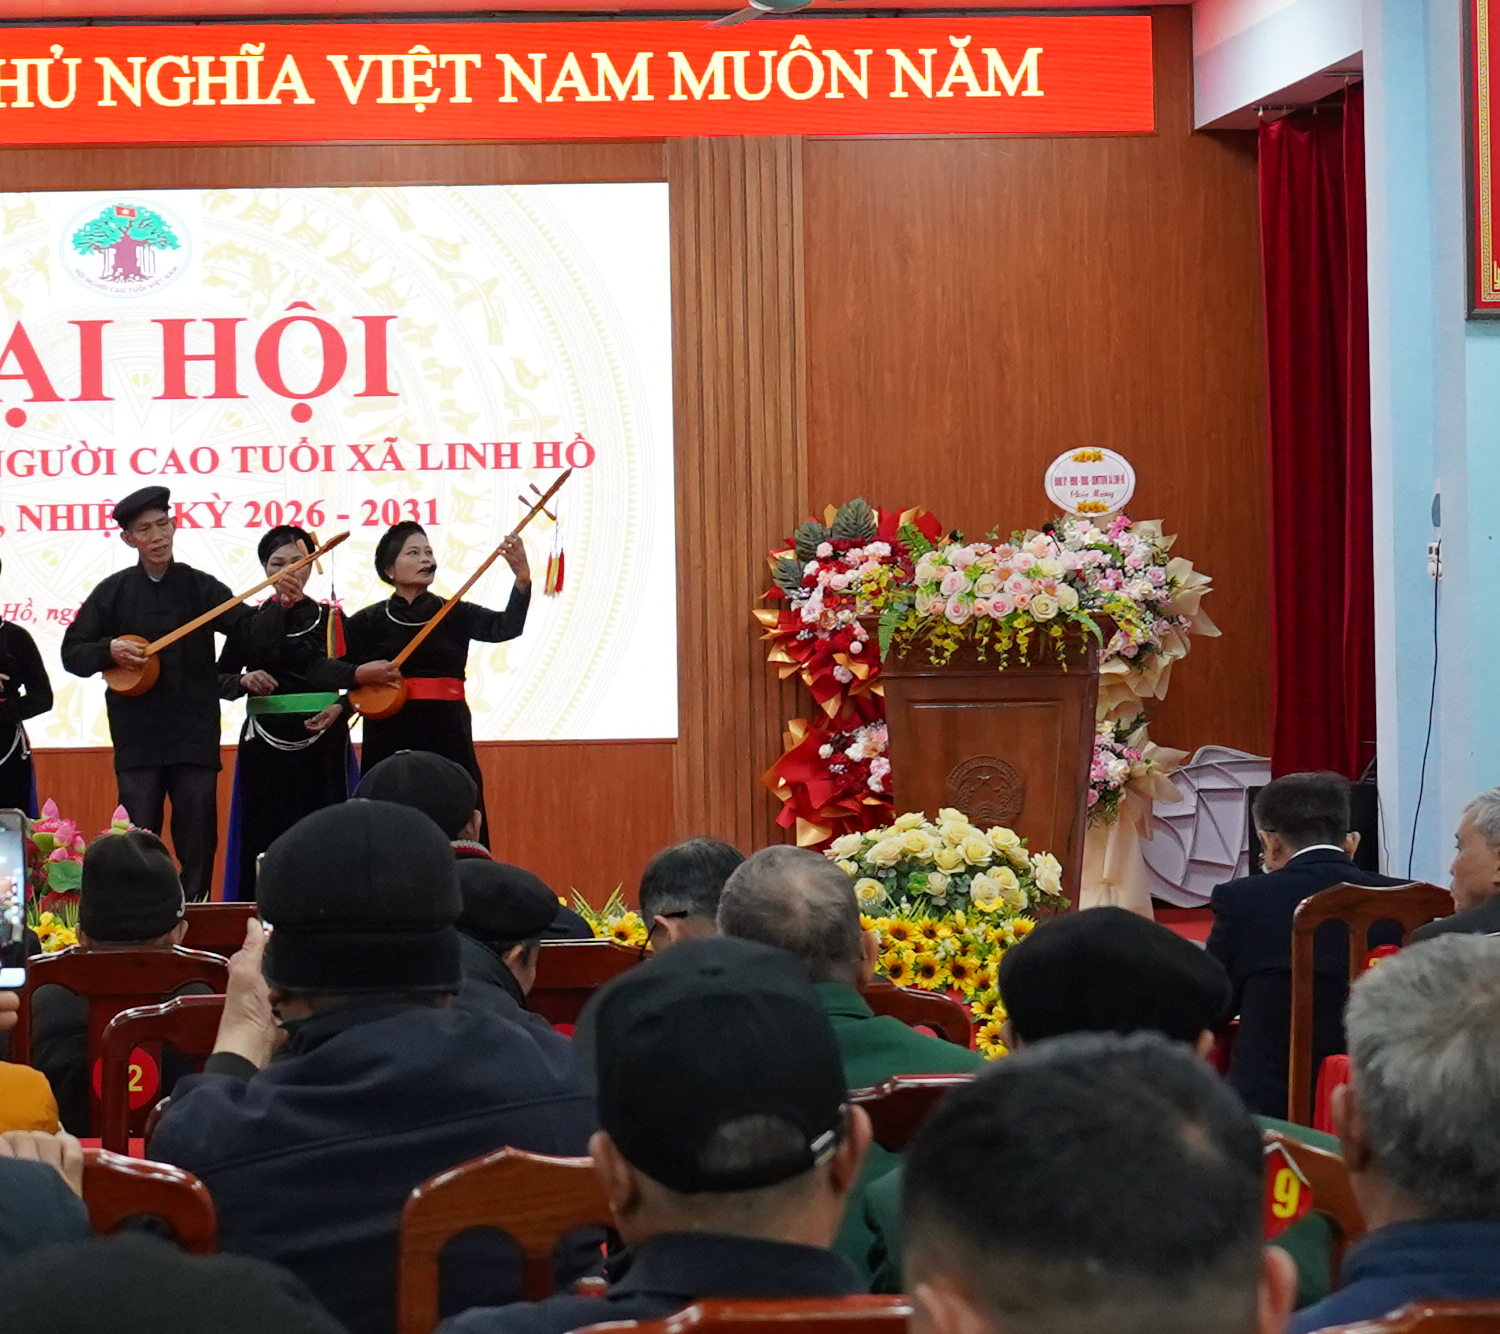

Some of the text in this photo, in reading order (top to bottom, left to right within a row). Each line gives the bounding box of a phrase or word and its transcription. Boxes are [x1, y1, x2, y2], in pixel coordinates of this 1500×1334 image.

[95, 41, 315, 107] NGHĨA
[327, 44, 481, 112] VIỆT
[496, 52, 654, 103] NAM
[668, 34, 873, 101] MUÔN
[886, 34, 1044, 98] NĂM
[152, 300, 399, 424] HỘI
[130, 447, 219, 475] CAO
[232, 436, 334, 473] TUỔI
[348, 437, 405, 471] XÃ
[419, 443, 520, 470] LINH
[534, 432, 595, 468] HỒ
[17, 499, 121, 538] NHIỆ
[175, 493, 232, 529] KỲ
[245, 499, 326, 528] 2026
[362, 497, 440, 527] 2031
[127, 1064, 143, 1092] 2
